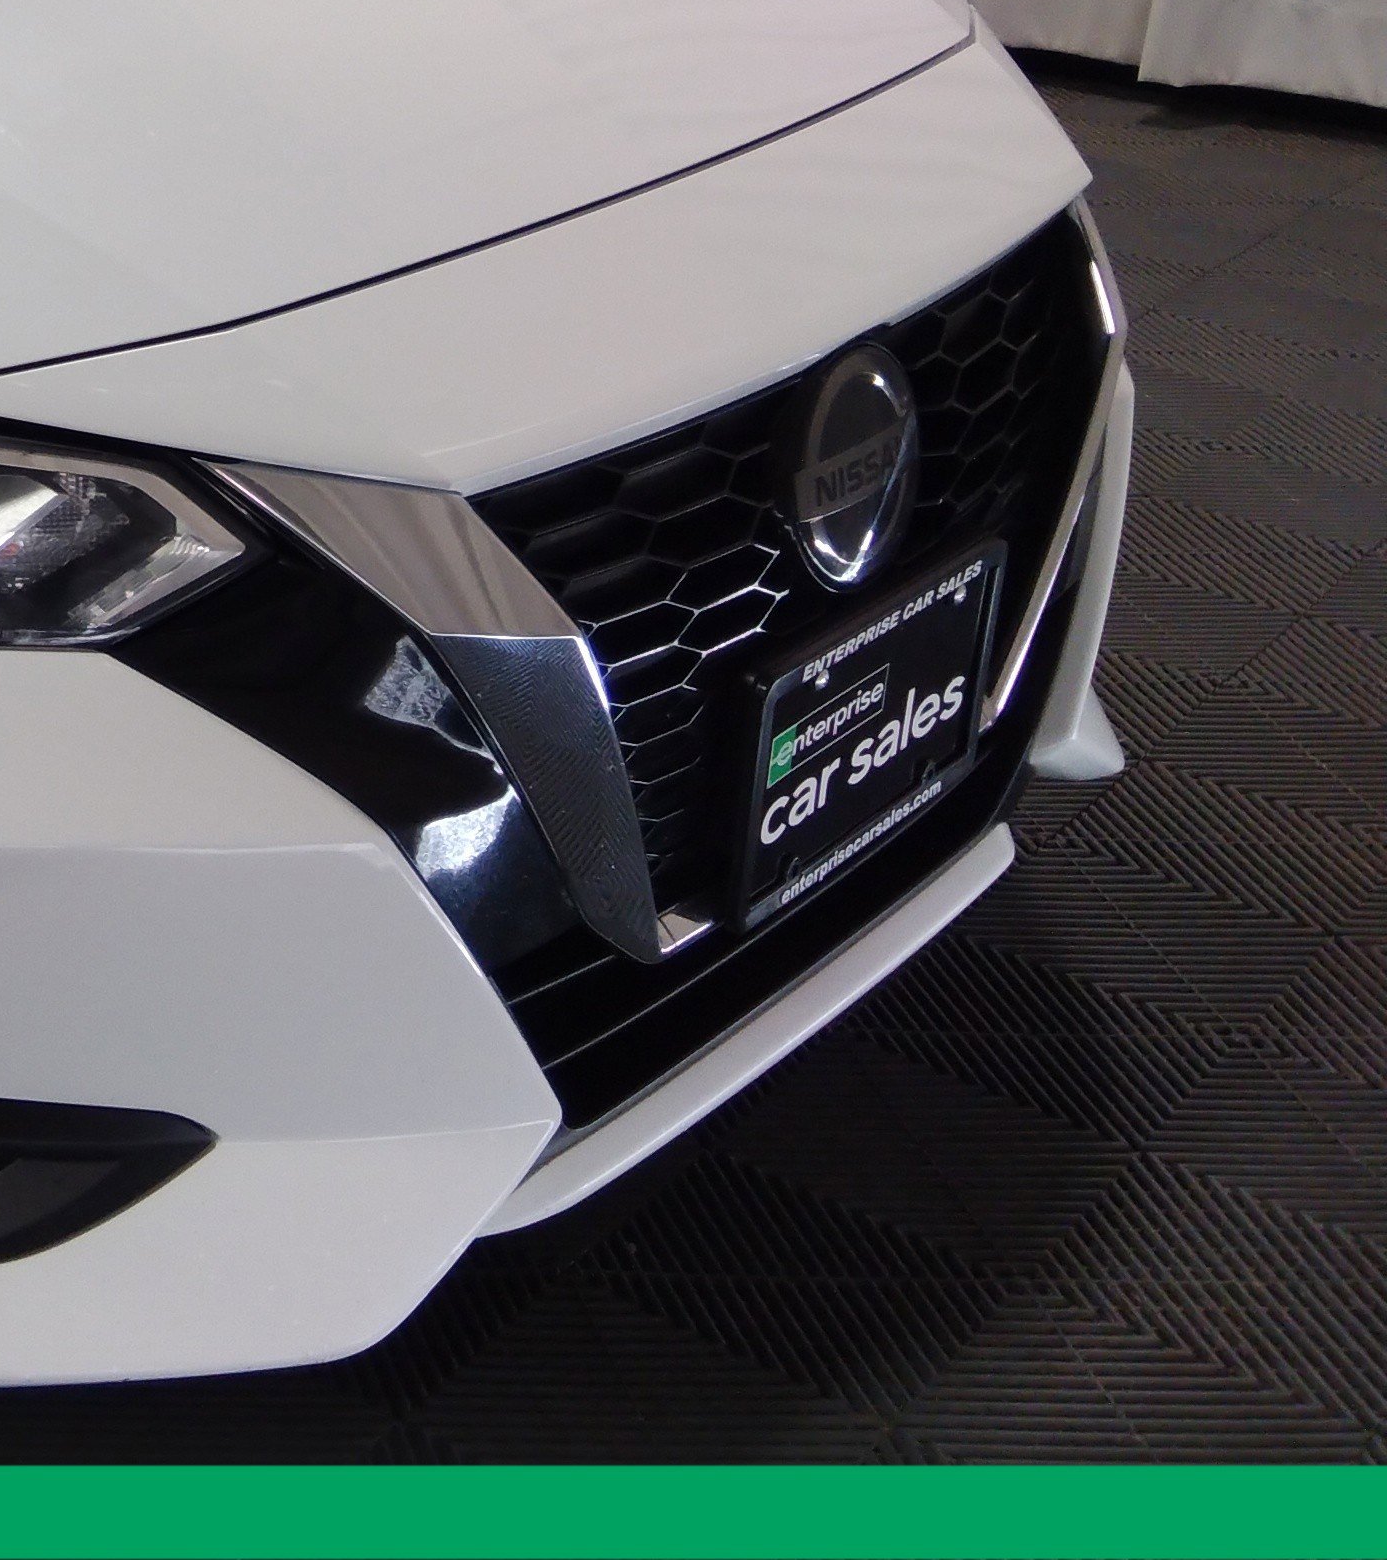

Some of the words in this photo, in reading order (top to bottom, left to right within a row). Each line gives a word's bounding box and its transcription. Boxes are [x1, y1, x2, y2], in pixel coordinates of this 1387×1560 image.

[813, 436, 901, 507] NISSA
[802, 609, 901, 682] ENTERPRISE
[902, 591, 934, 621] CAR
[936, 559, 983, 602] SALES
[760, 755, 842, 844] car
[847, 675, 966, 785] sales
[772, 681, 885, 766] enterprise
[780, 780, 942, 906] enterprisecarsales.com
